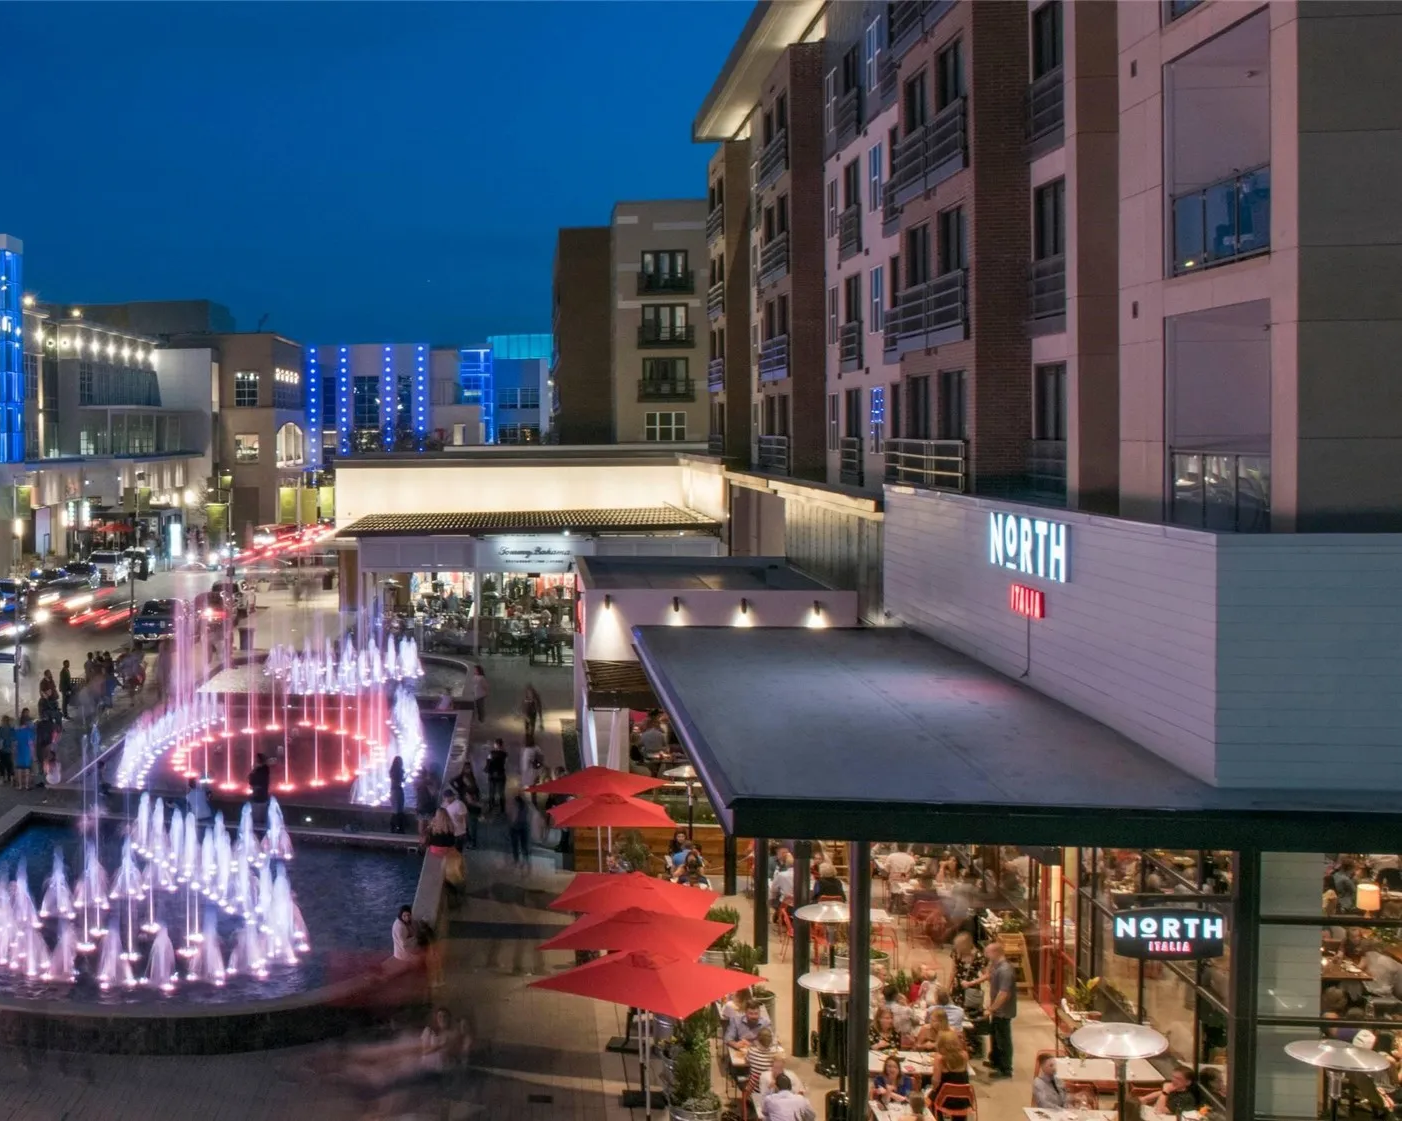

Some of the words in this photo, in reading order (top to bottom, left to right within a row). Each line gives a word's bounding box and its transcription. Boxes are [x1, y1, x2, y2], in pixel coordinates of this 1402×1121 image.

[498, 546, 533, 558] Tommy
[533, 546, 571, 556] Bahama
[989, 511, 1068, 583] NORTH
[1010, 584, 1043, 618] ITALIA
[1115, 916, 1224, 939] NORTH
[1148, 940, 1191, 953] ITALIA
